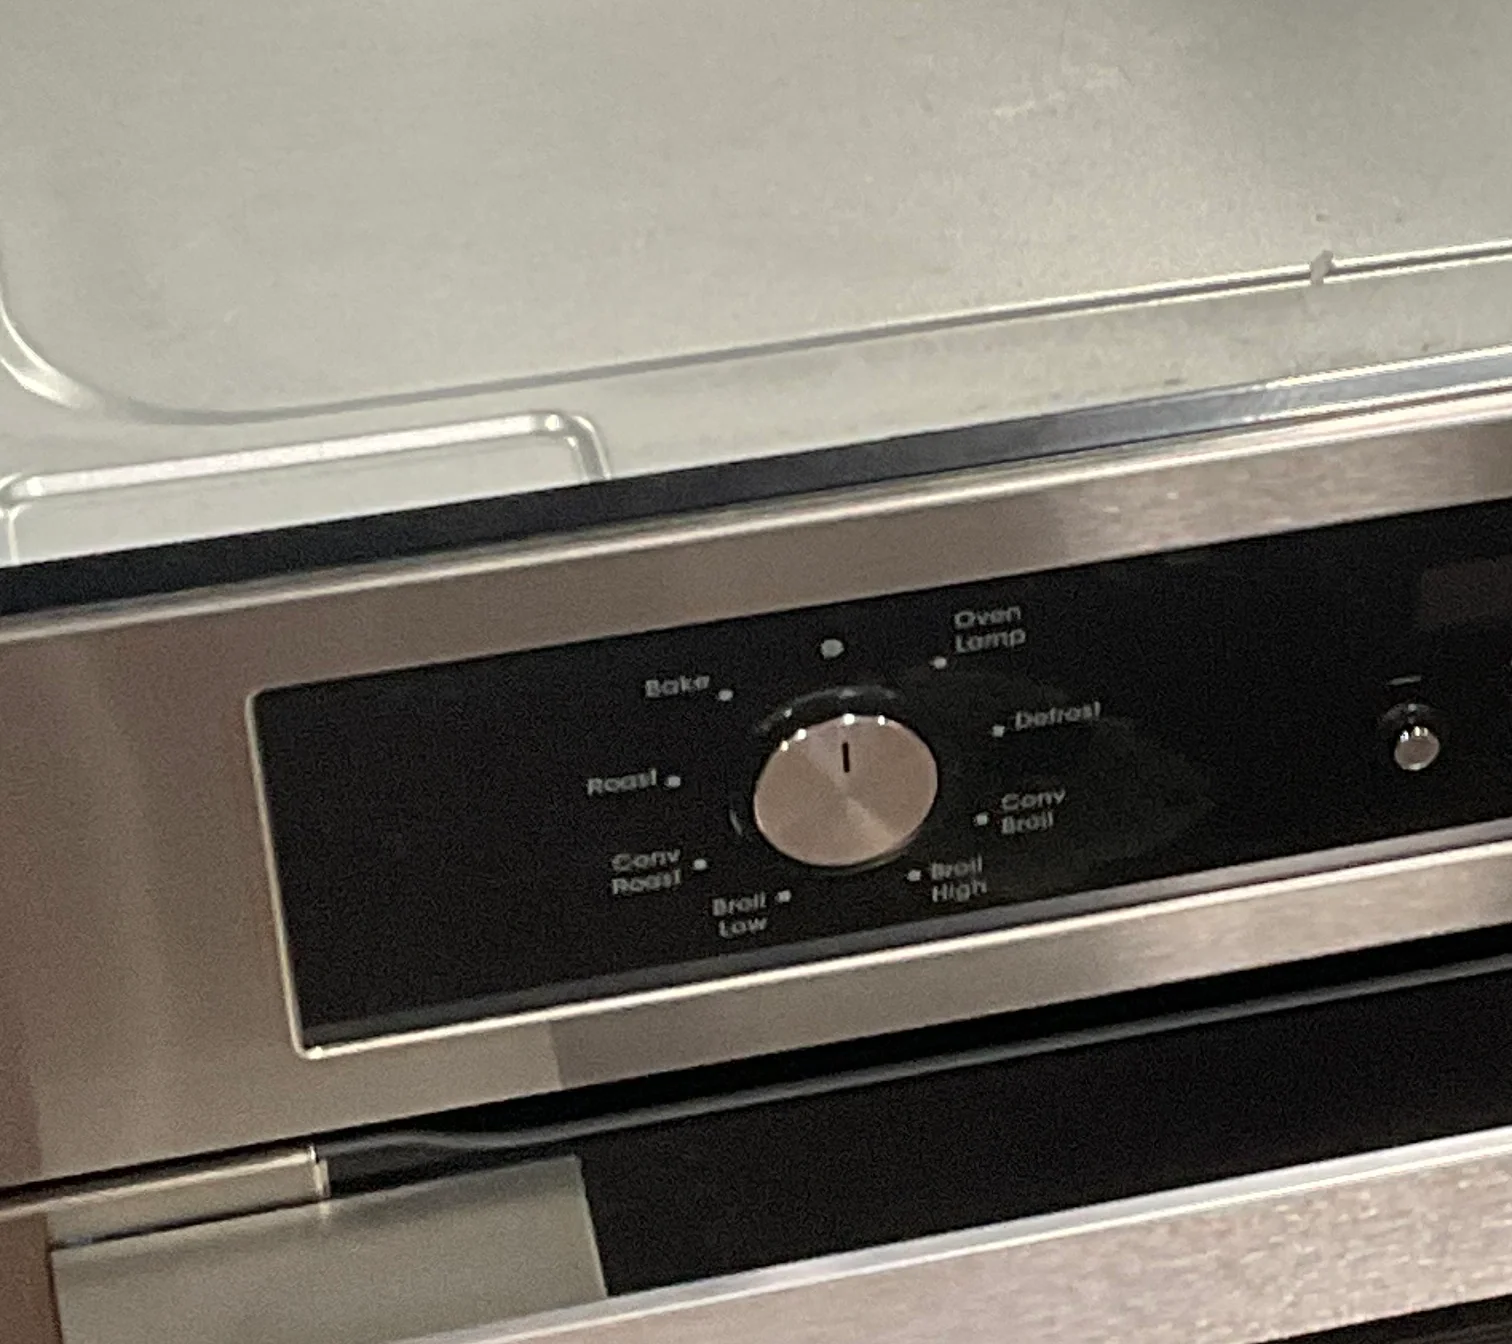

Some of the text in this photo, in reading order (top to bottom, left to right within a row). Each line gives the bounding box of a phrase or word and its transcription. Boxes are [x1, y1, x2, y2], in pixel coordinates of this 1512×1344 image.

[954, 606, 1021, 629] Oven
[955, 628, 1026, 653] Lamp
[645, 674, 710, 698] Bake
[1014, 701, 1101, 731] Defrost
[586, 767, 657, 796] Roast
[1001, 787, 1066, 811] Conv
[1002, 811, 1054, 835] Broil
[611, 849, 680, 872] Conv
[930, 855, 983, 881] Broil
[611, 868, 680, 895] Roast
[932, 878, 987, 903] High
[712, 891, 766, 917] Broil
[719, 917, 768, 939] Low
